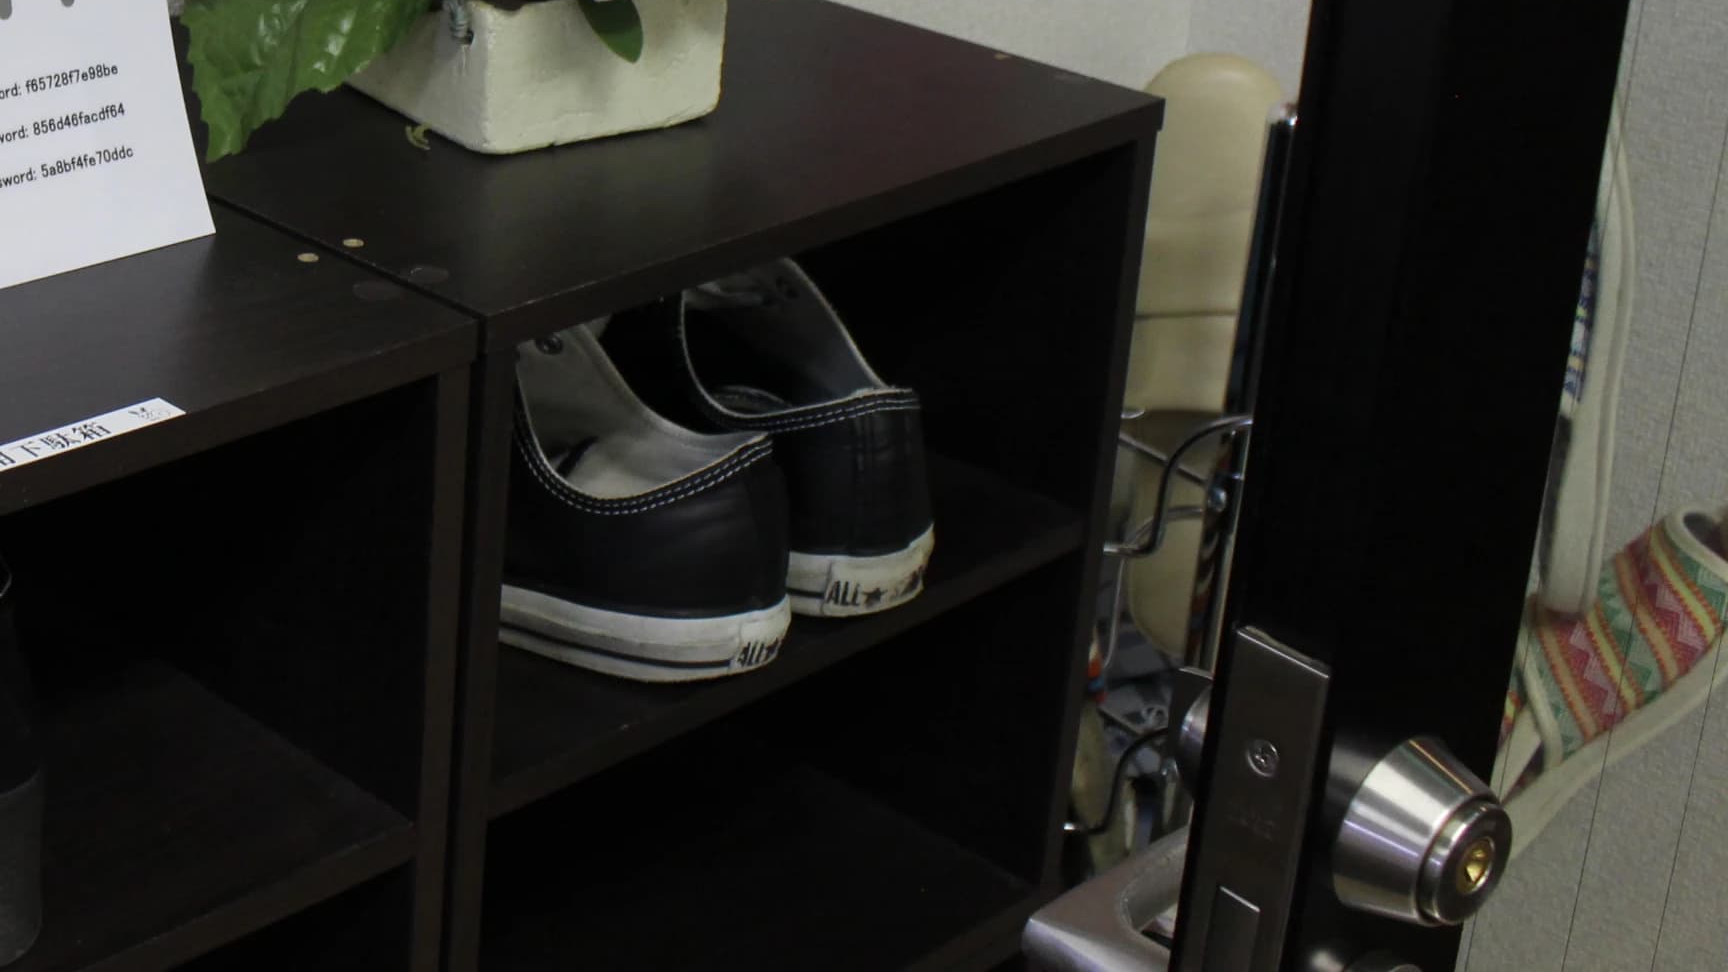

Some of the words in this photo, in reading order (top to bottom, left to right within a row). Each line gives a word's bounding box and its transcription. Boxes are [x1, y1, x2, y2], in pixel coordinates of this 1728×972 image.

[25, 63, 119, 95] f65728f7e98be
[33, 102, 126, 136] 856d46facdf64
[41, 144, 134, 179] 5a8bf4fe70ddc
